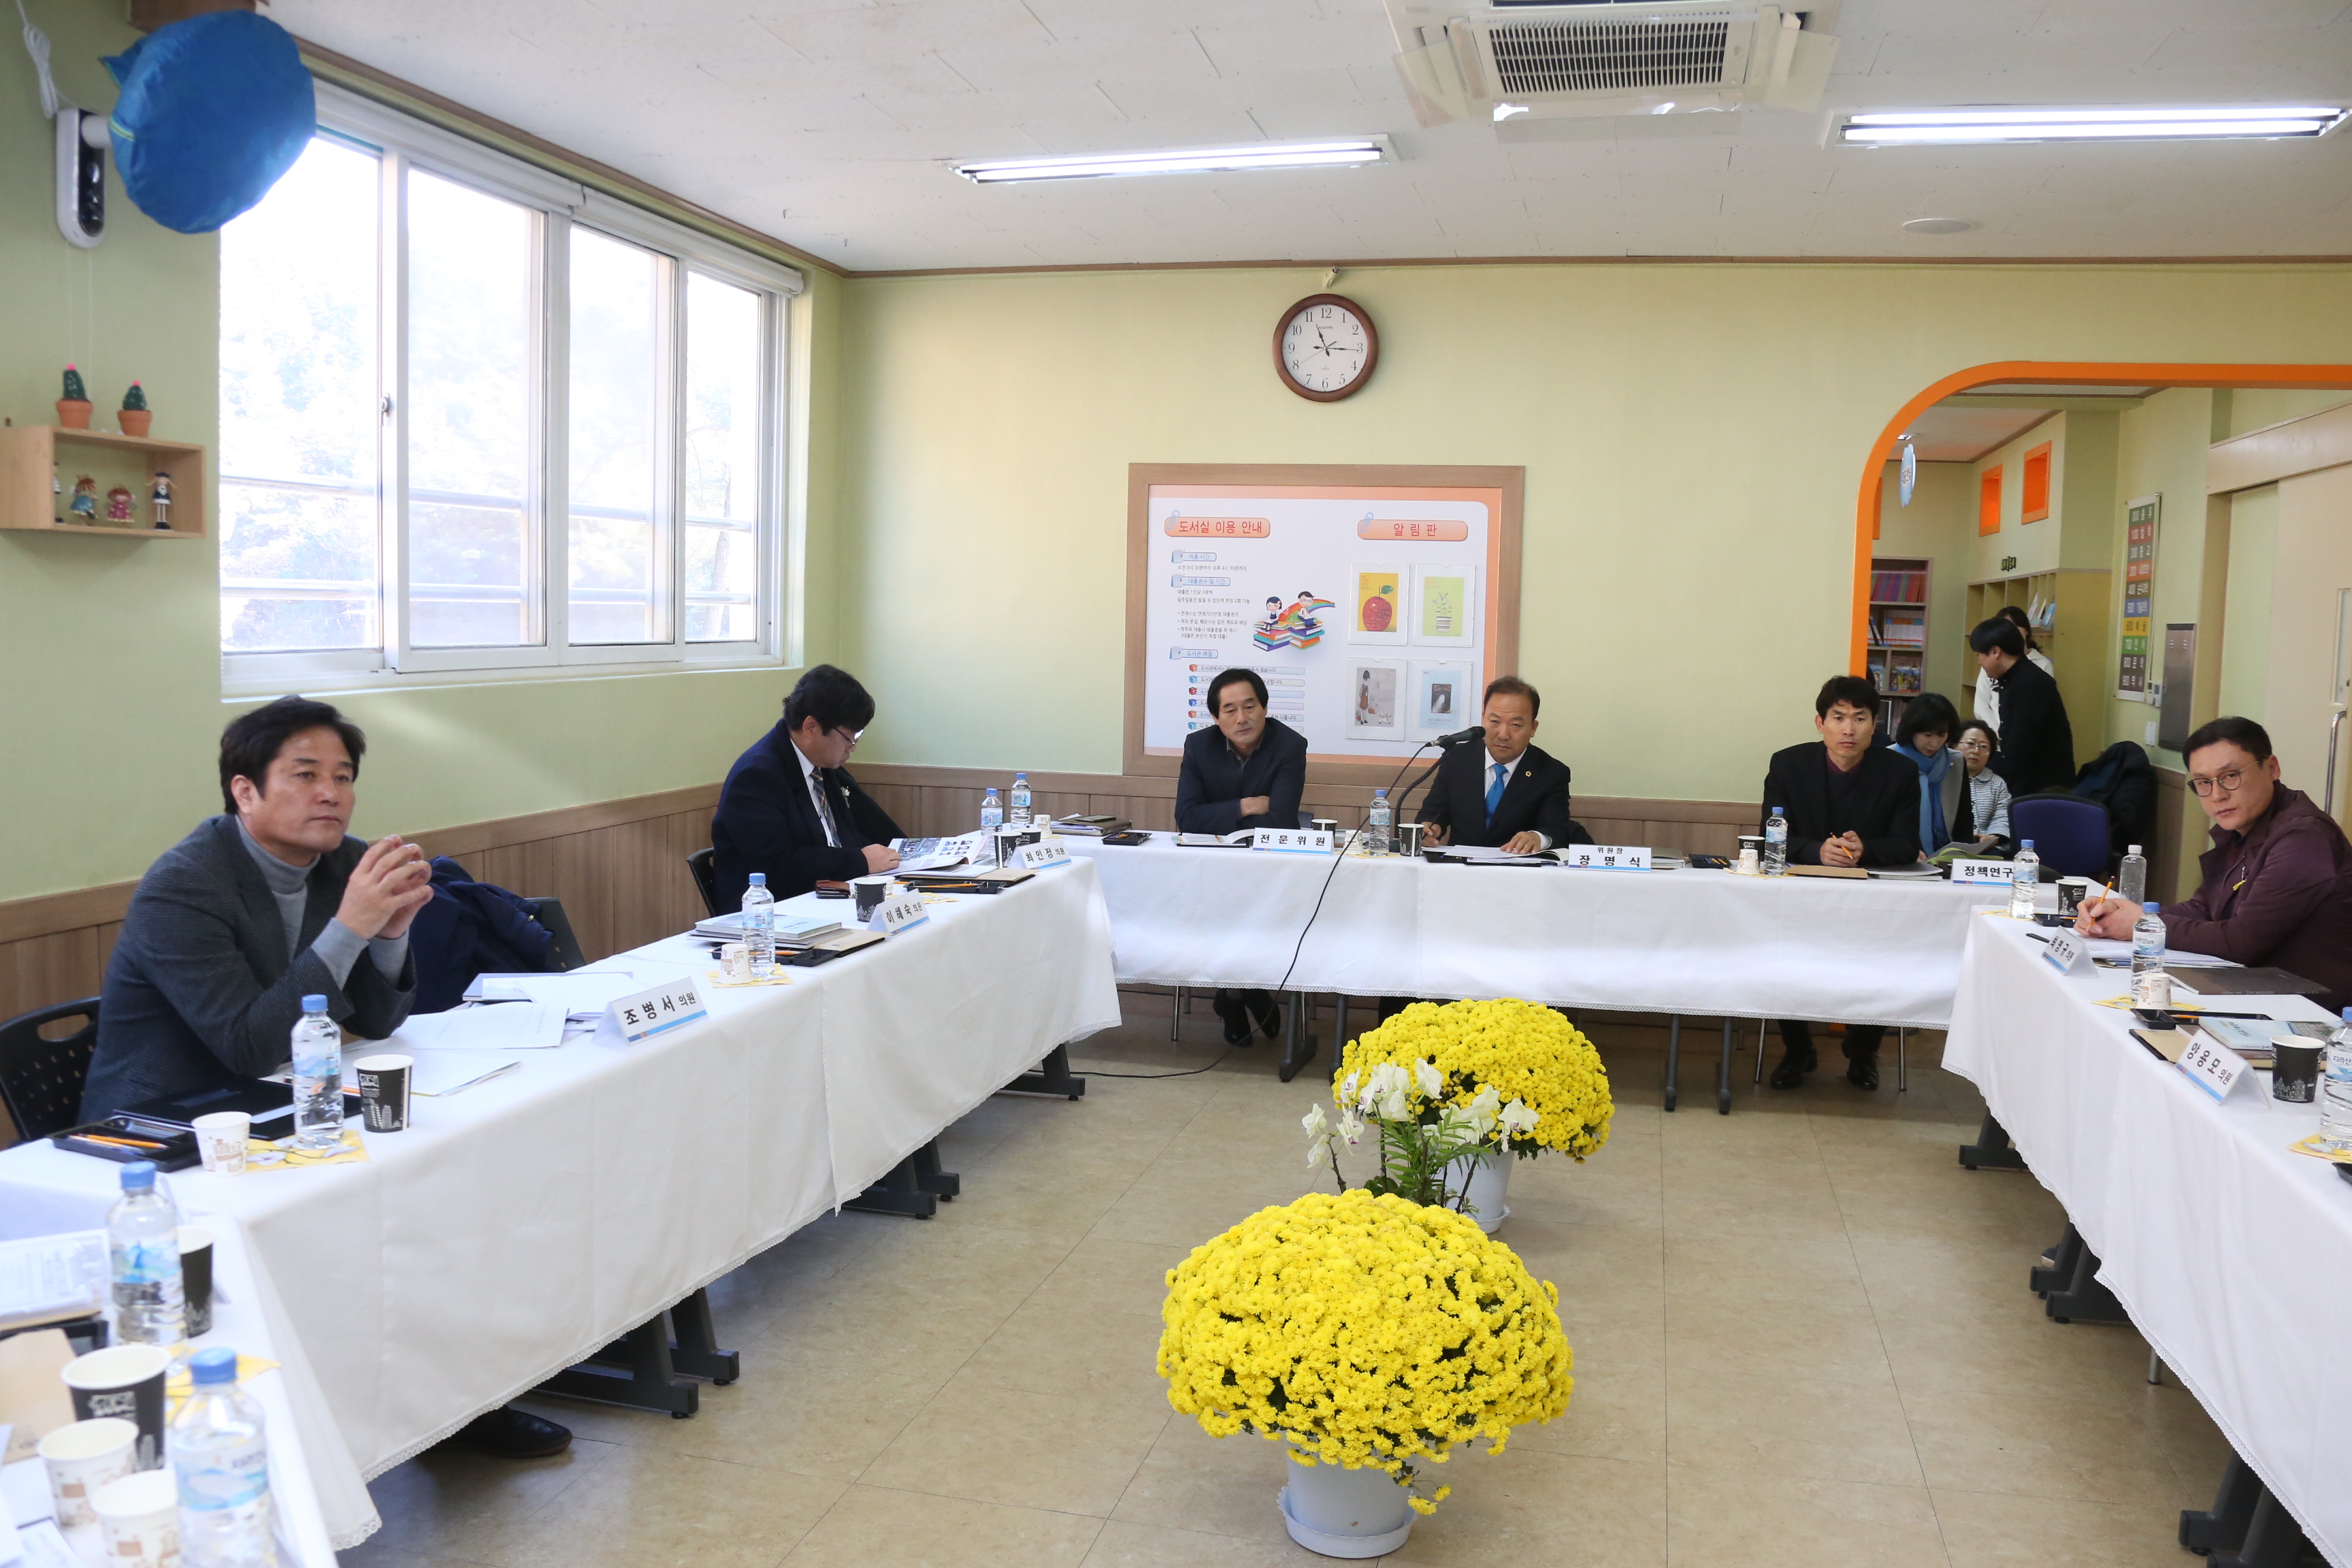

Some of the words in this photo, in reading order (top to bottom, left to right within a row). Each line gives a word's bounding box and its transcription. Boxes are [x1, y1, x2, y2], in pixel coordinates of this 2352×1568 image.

[1305, 312, 1313, 323] 11
[1321, 308, 1332, 318] 12
[1342, 312, 1346, 323] 1
[1292, 325, 1302, 336] 10
[1352, 324, 1358, 335] 2
[1288, 343, 1295, 354] 9
[1356, 343, 1363, 353] 3
[1292, 359, 1299, 370] 8
[1351, 361, 1358, 370] 4
[1305, 374, 1312, 385] 7
[1322, 378, 1328, 389] 6
[1339, 374, 1345, 385] 5
[1179, 521, 1209, 534] 도서실
[1215, 521, 1236, 534] 이용
[1241, 521, 1262, 534] 안내
[1055, 847, 1065, 855] 의원
[913, 902, 923, 912] 의원
[679, 992, 696, 1006] 의원
[2218, 1069, 2233, 1085] 의원
